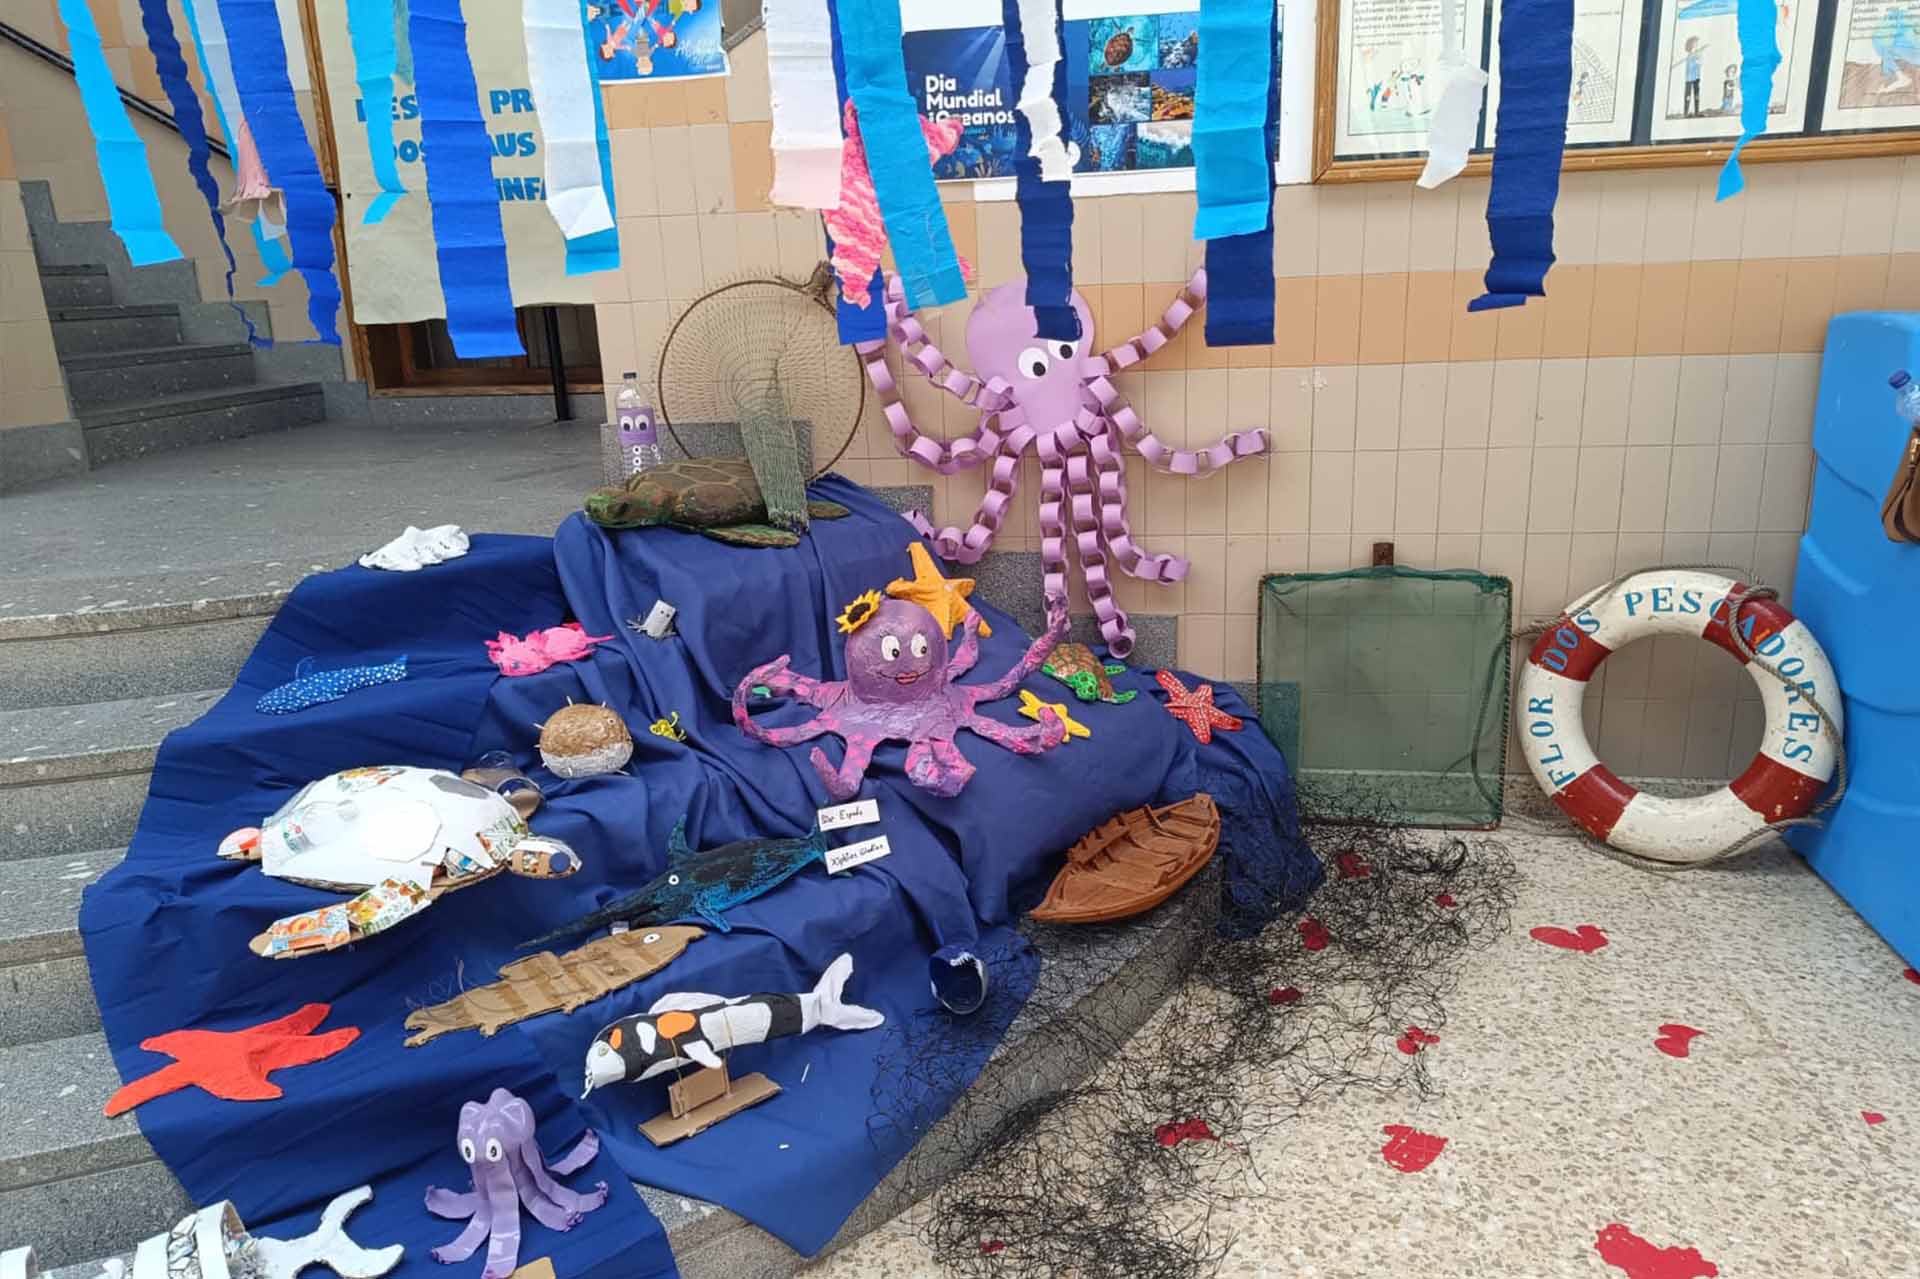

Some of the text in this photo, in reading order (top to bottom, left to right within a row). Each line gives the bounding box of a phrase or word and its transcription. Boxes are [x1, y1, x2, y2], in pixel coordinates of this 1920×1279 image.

[925, 74, 956, 92] Dia
[490, 88, 537, 115] PR
[926, 88, 1003, 110] Mundial
[1528, 586, 1820, 786] FLOR DOS PESCADORES
